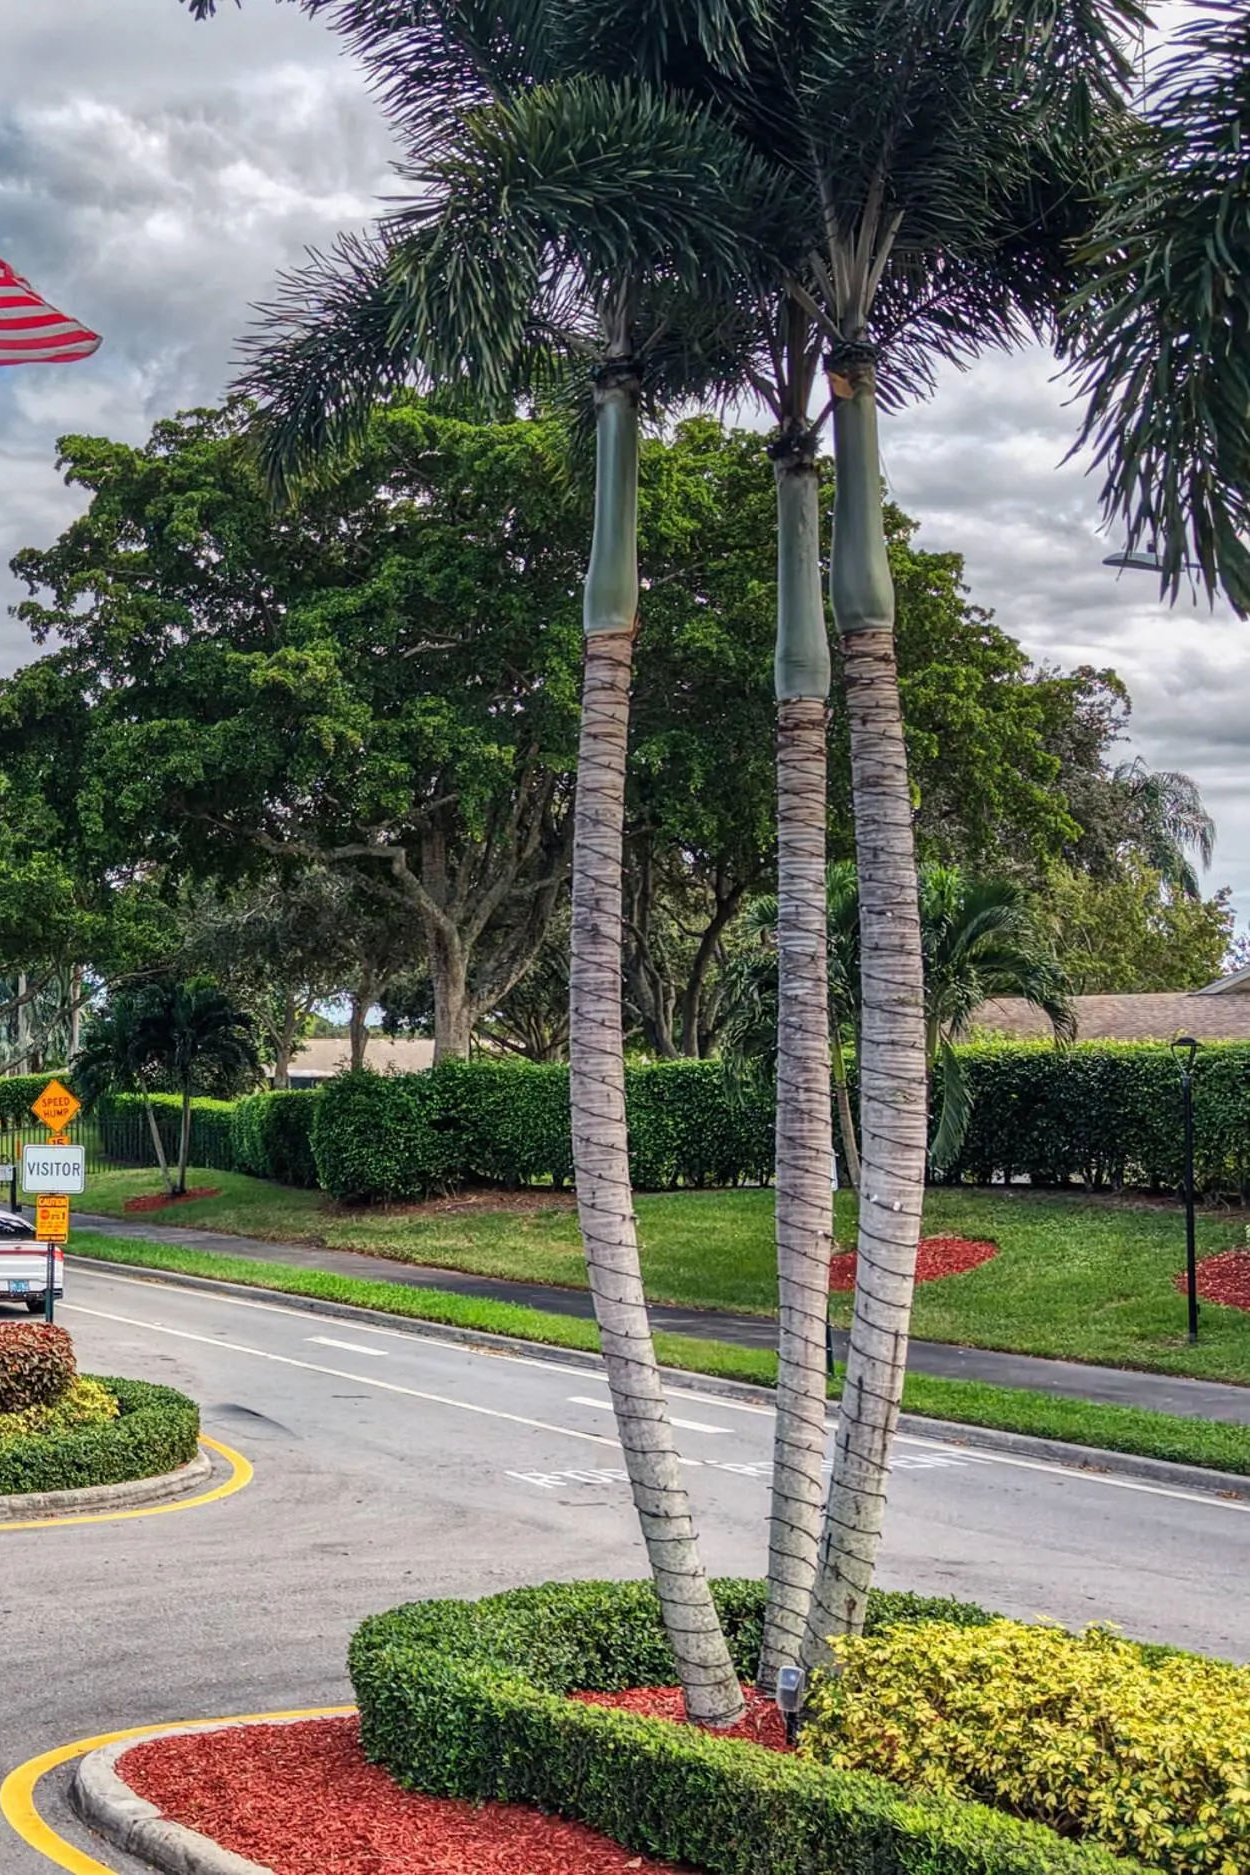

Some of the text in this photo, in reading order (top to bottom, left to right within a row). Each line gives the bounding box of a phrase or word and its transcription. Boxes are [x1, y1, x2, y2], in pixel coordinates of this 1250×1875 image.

[42, 1097, 70, 1107] SPEED
[43, 1108, 69, 1117] HUMP
[27, 1161, 80, 1177] VISITOR
